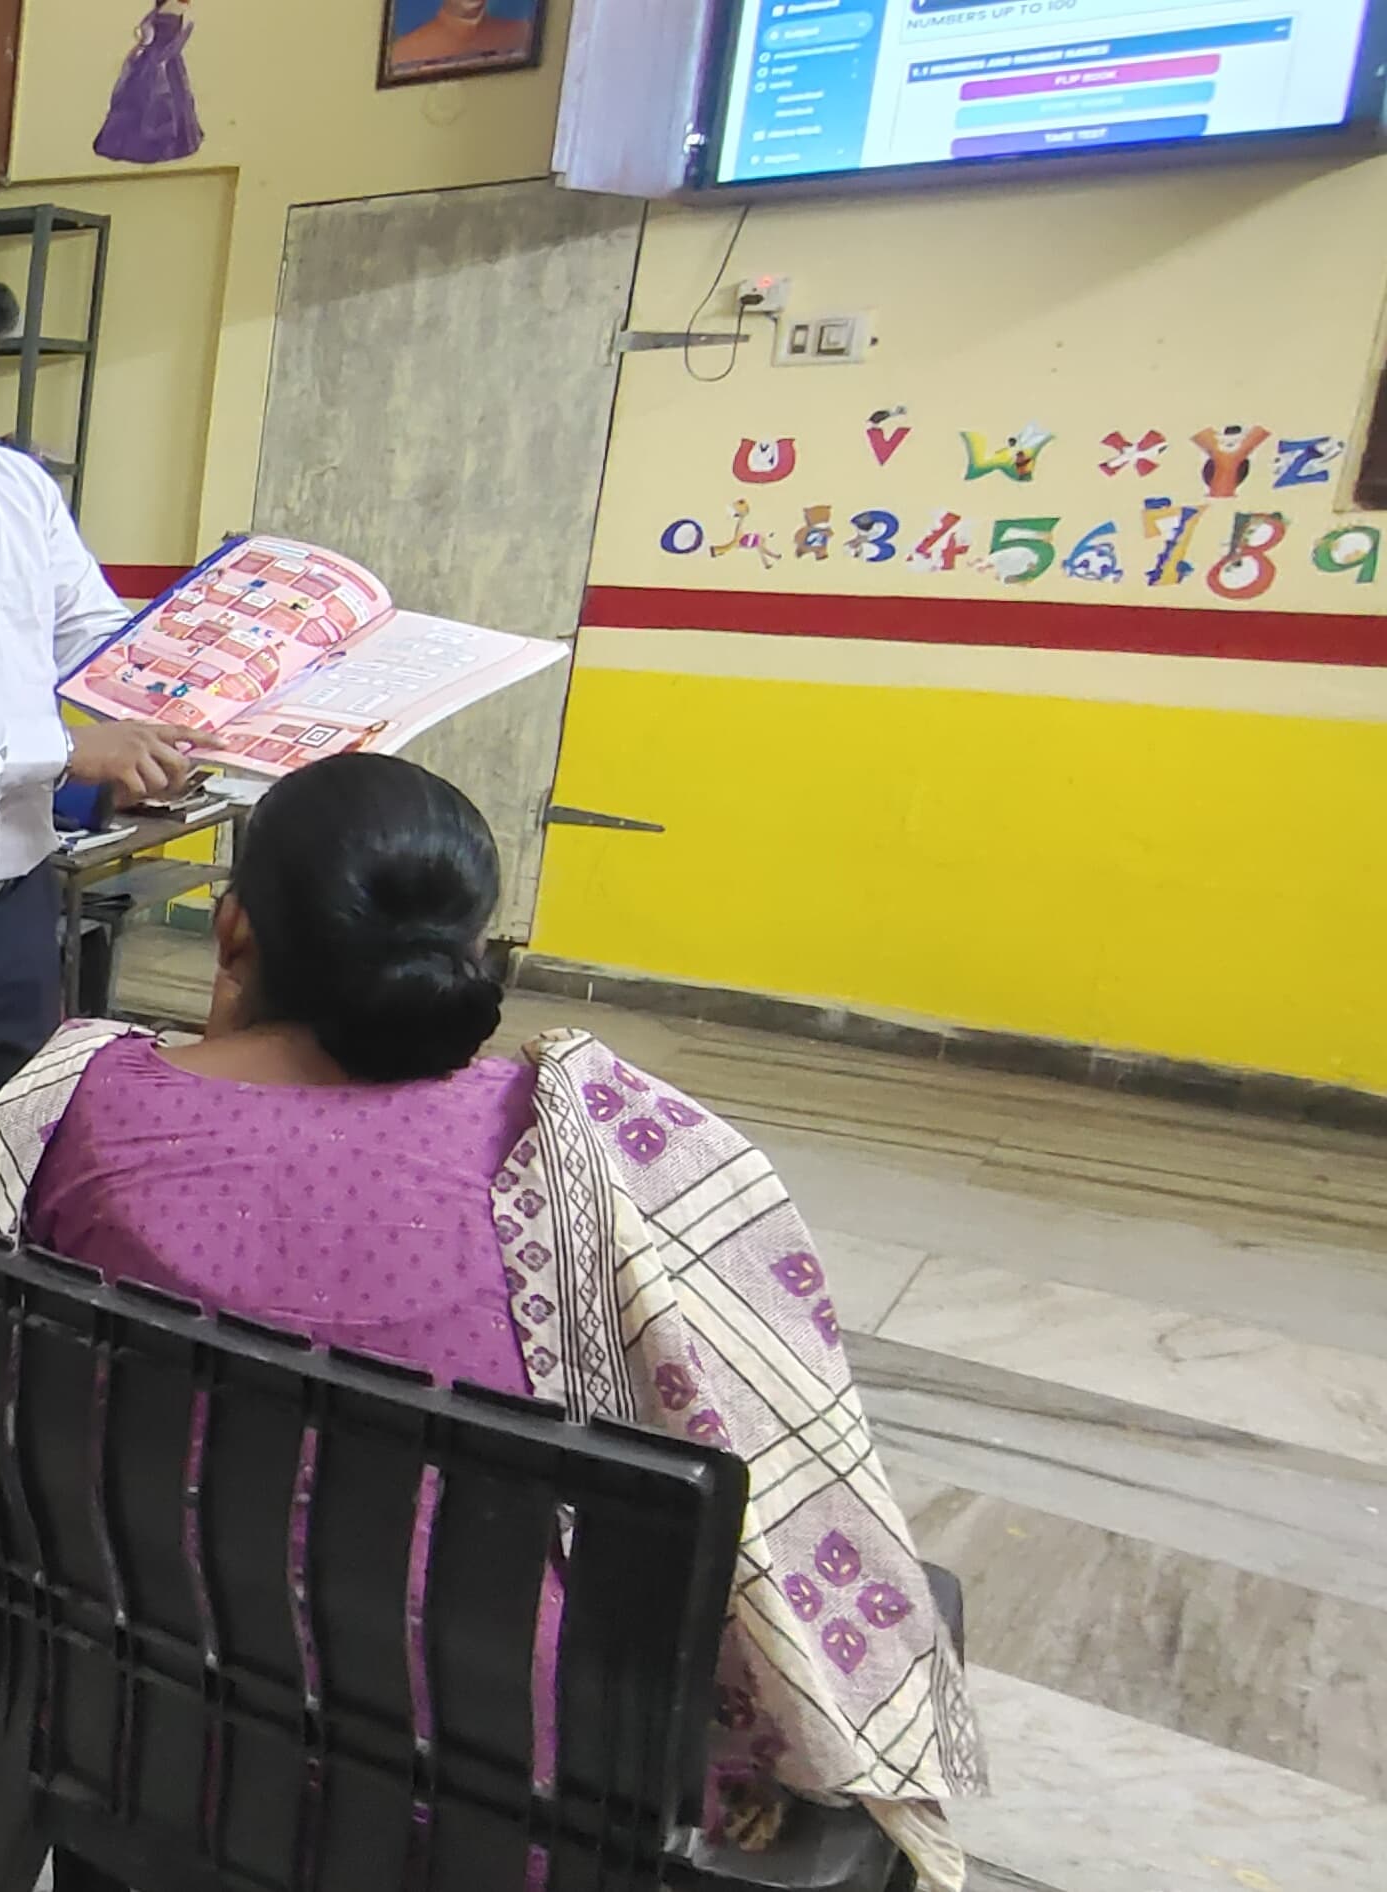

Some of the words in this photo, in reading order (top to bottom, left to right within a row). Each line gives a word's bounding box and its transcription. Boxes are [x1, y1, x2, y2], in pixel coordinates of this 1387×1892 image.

[906, 9, 987, 30] NUMBERS
[991, 6, 1015, 20] UP
[1020, 2, 1043, 16] TO
[732, 438, 796, 483] U
[958, 428, 1055, 482] W
[1190, 425, 1271, 498] Y
[1272, 436, 1331, 488] Z
[844, 510, 899, 562] 3
[914, 512, 970, 570] 4
[988, 516, 1060, 584] 5
[1065, 520, 1123, 582] 6
[1142, 502, 1211, 587] 7
[1207, 512, 1287, 601] 8
[1313, 526, 1381, 584] 9
